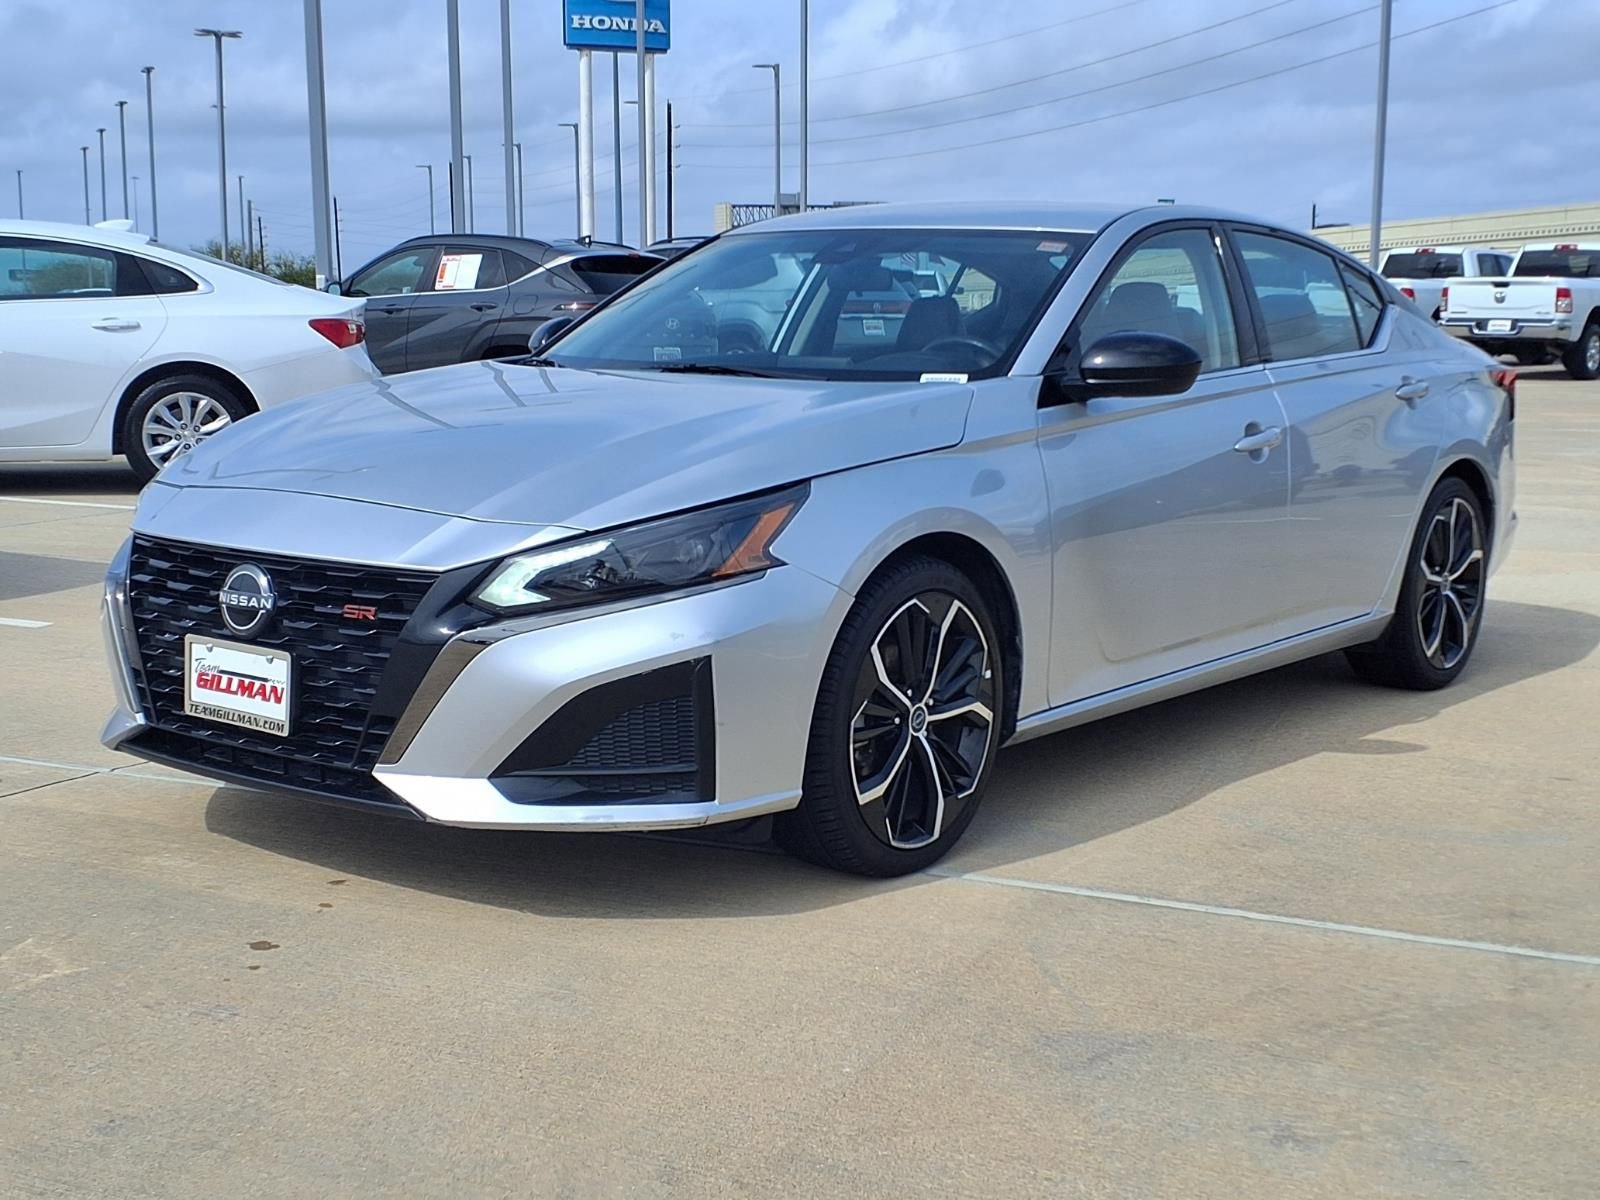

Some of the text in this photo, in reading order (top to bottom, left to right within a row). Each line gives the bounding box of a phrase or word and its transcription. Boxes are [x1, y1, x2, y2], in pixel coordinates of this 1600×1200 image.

[219, 591, 272, 609] NISSAN
[343, 604, 377, 620] SR
[194, 658, 220, 674] Team
[196, 672, 285, 705] GILLMAN
[190, 703, 285, 734] TEAMGILLMAN.COM
